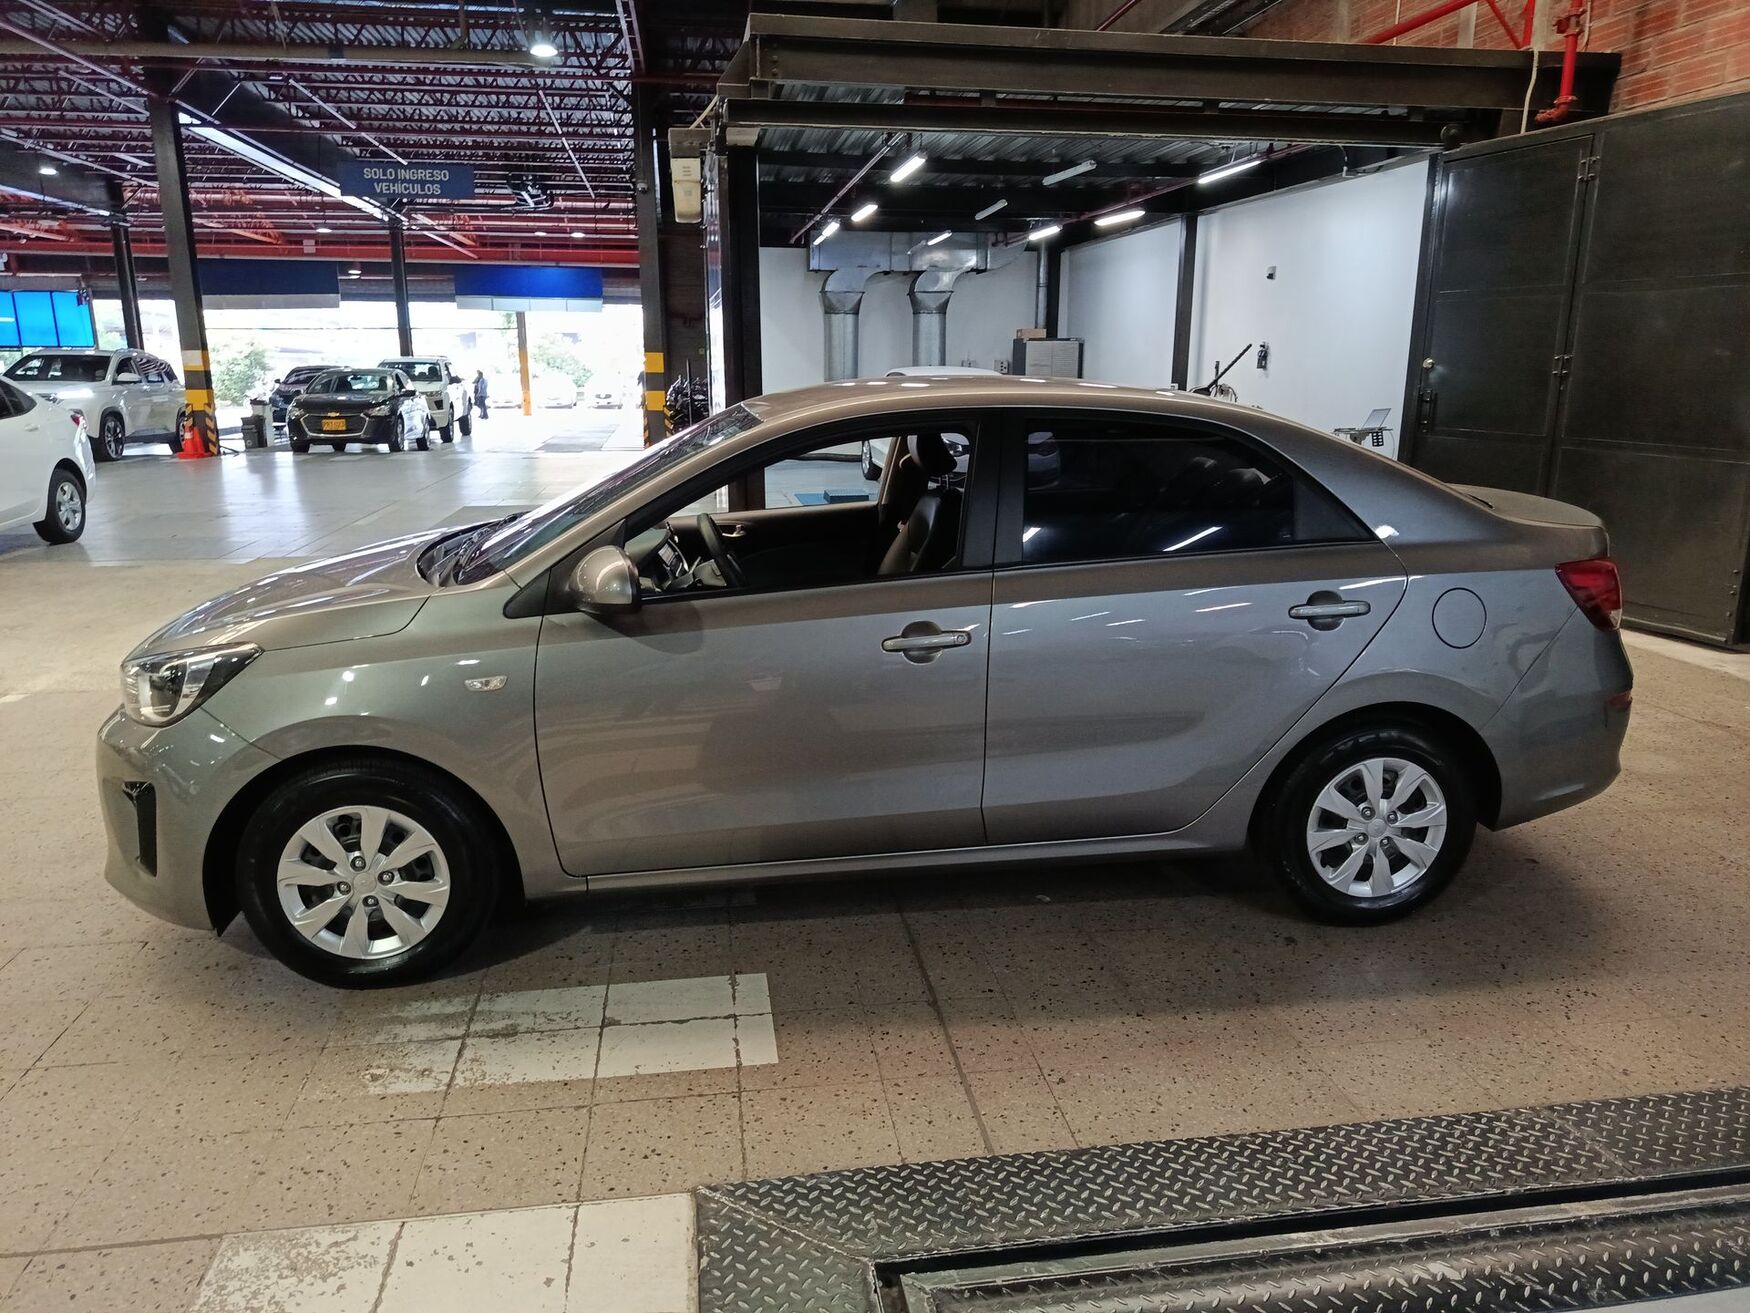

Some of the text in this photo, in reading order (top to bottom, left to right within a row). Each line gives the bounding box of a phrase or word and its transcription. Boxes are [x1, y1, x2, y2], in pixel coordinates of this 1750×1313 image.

[363, 168, 449, 181] SOLO INGRESO
[374, 181, 441, 195] VEHÍCULOS
